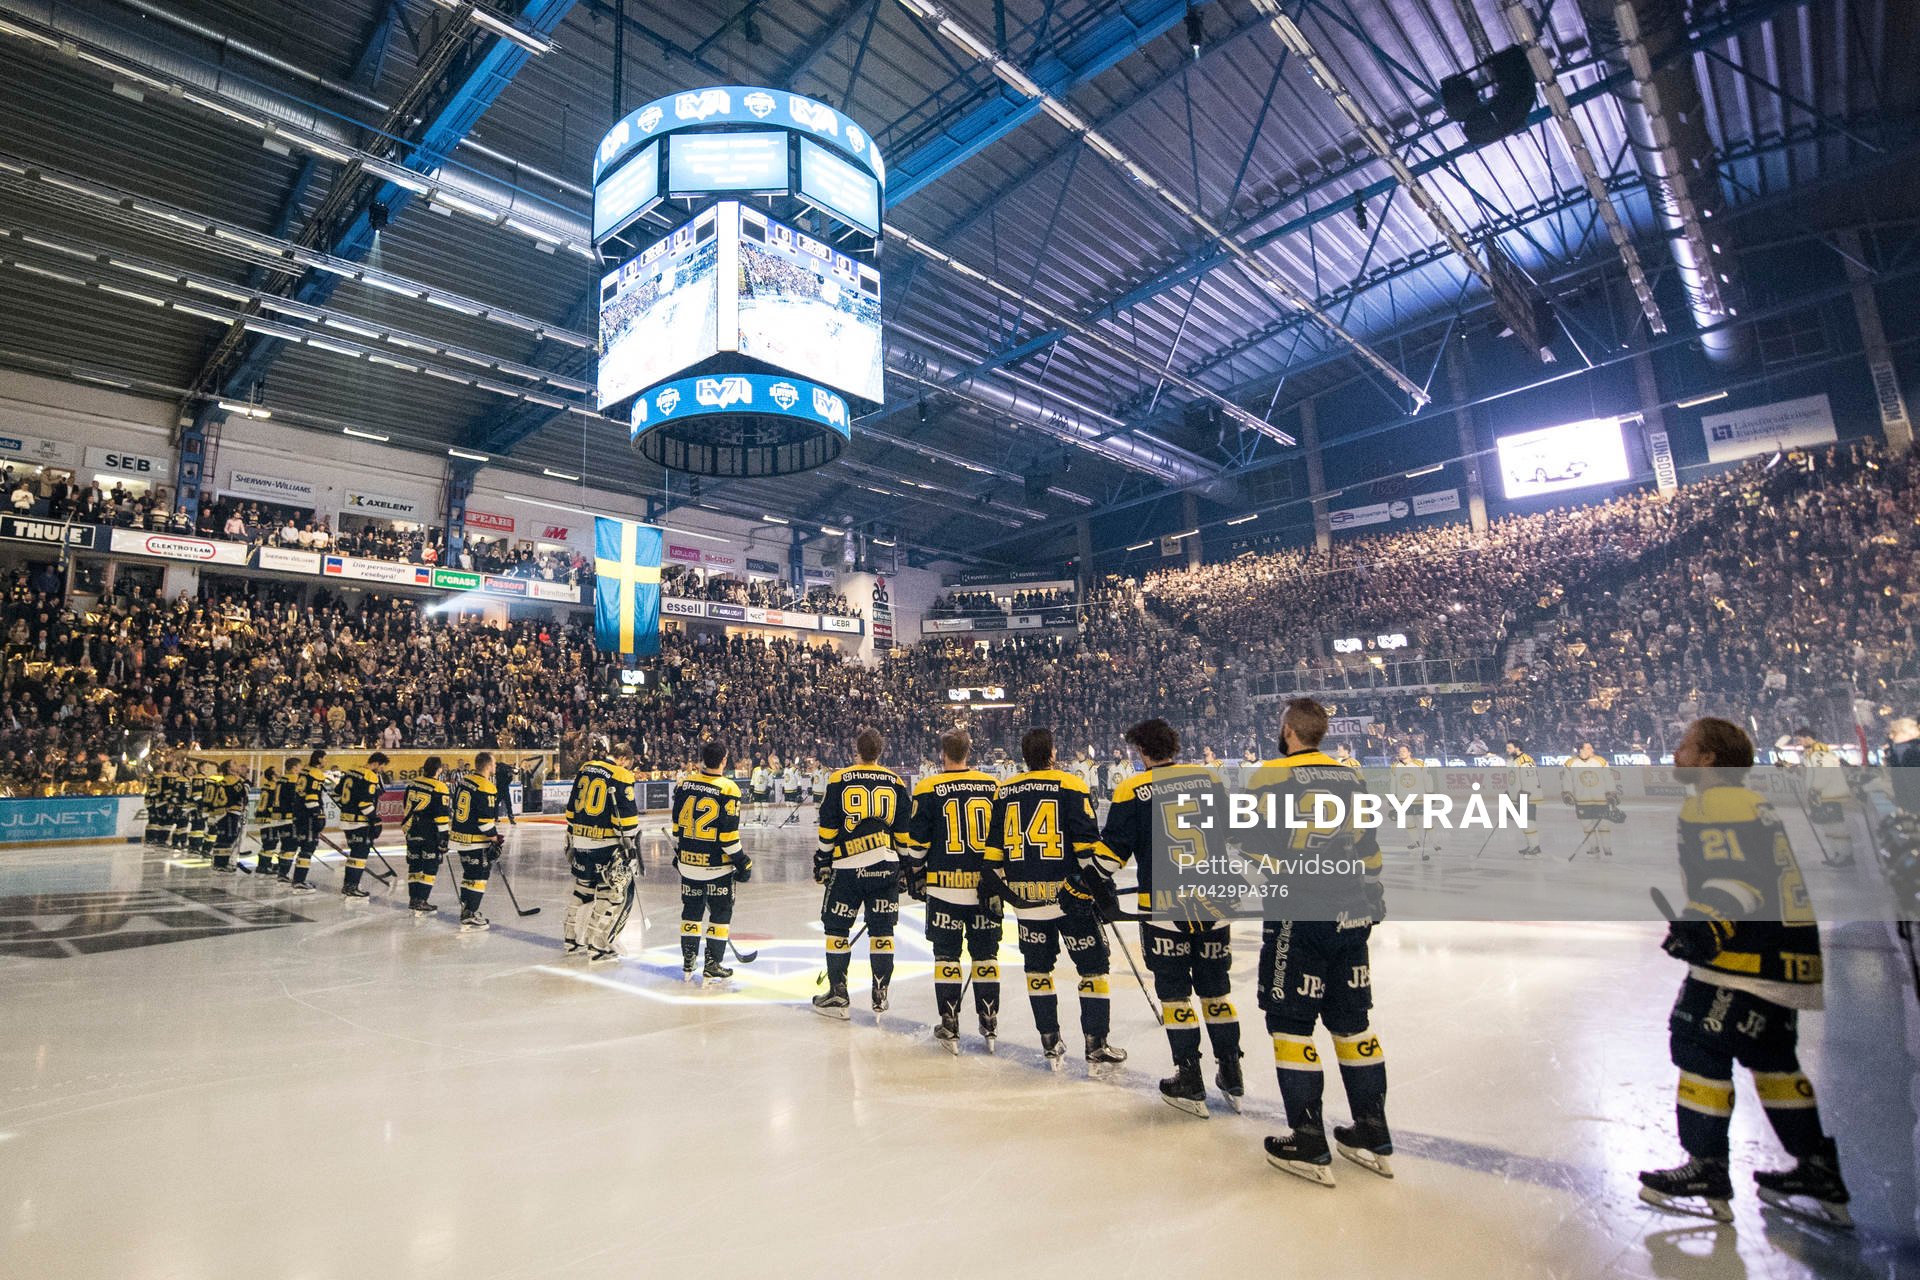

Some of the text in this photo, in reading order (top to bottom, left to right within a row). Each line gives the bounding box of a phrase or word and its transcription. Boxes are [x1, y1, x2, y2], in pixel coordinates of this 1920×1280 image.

[105, 454, 151, 473] SEB
[1653, 440, 1675, 487] UNGDOM
[366, 498, 414, 512] AXELENT
[666, 602, 701, 615] essell
[852, 772, 896, 784] Husqvarna
[687, 783, 720, 797] Husqvarna
[946, 783, 996, 793] Husqvarna
[1008, 780, 1059, 795] Husqvarna
[1150, 777, 1212, 797] Husqvarna
[574, 775, 608, 817] 30
[842, 785, 897, 833] 90
[1, 810, 99, 828] JUNET
[678, 795, 721, 842] 42
[943, 796, 993, 854] 10
[1003, 800, 1064, 861] 44
[1160, 797, 1209, 868] 5
[1700, 828, 1746, 862] 21
[680, 852, 710, 867] REESE
[706, 883, 729, 896] JP.se
[684, 923, 698, 932] GA
[834, 939, 850, 949] GA
[875, 939, 891, 949] GA
[1151, 937, 1191, 957] JP.se
[942, 966, 961, 978] GA
[977, 966, 997, 977] GA
[1030, 978, 1052, 990] GA
[1208, 1003, 1232, 1017] GA
